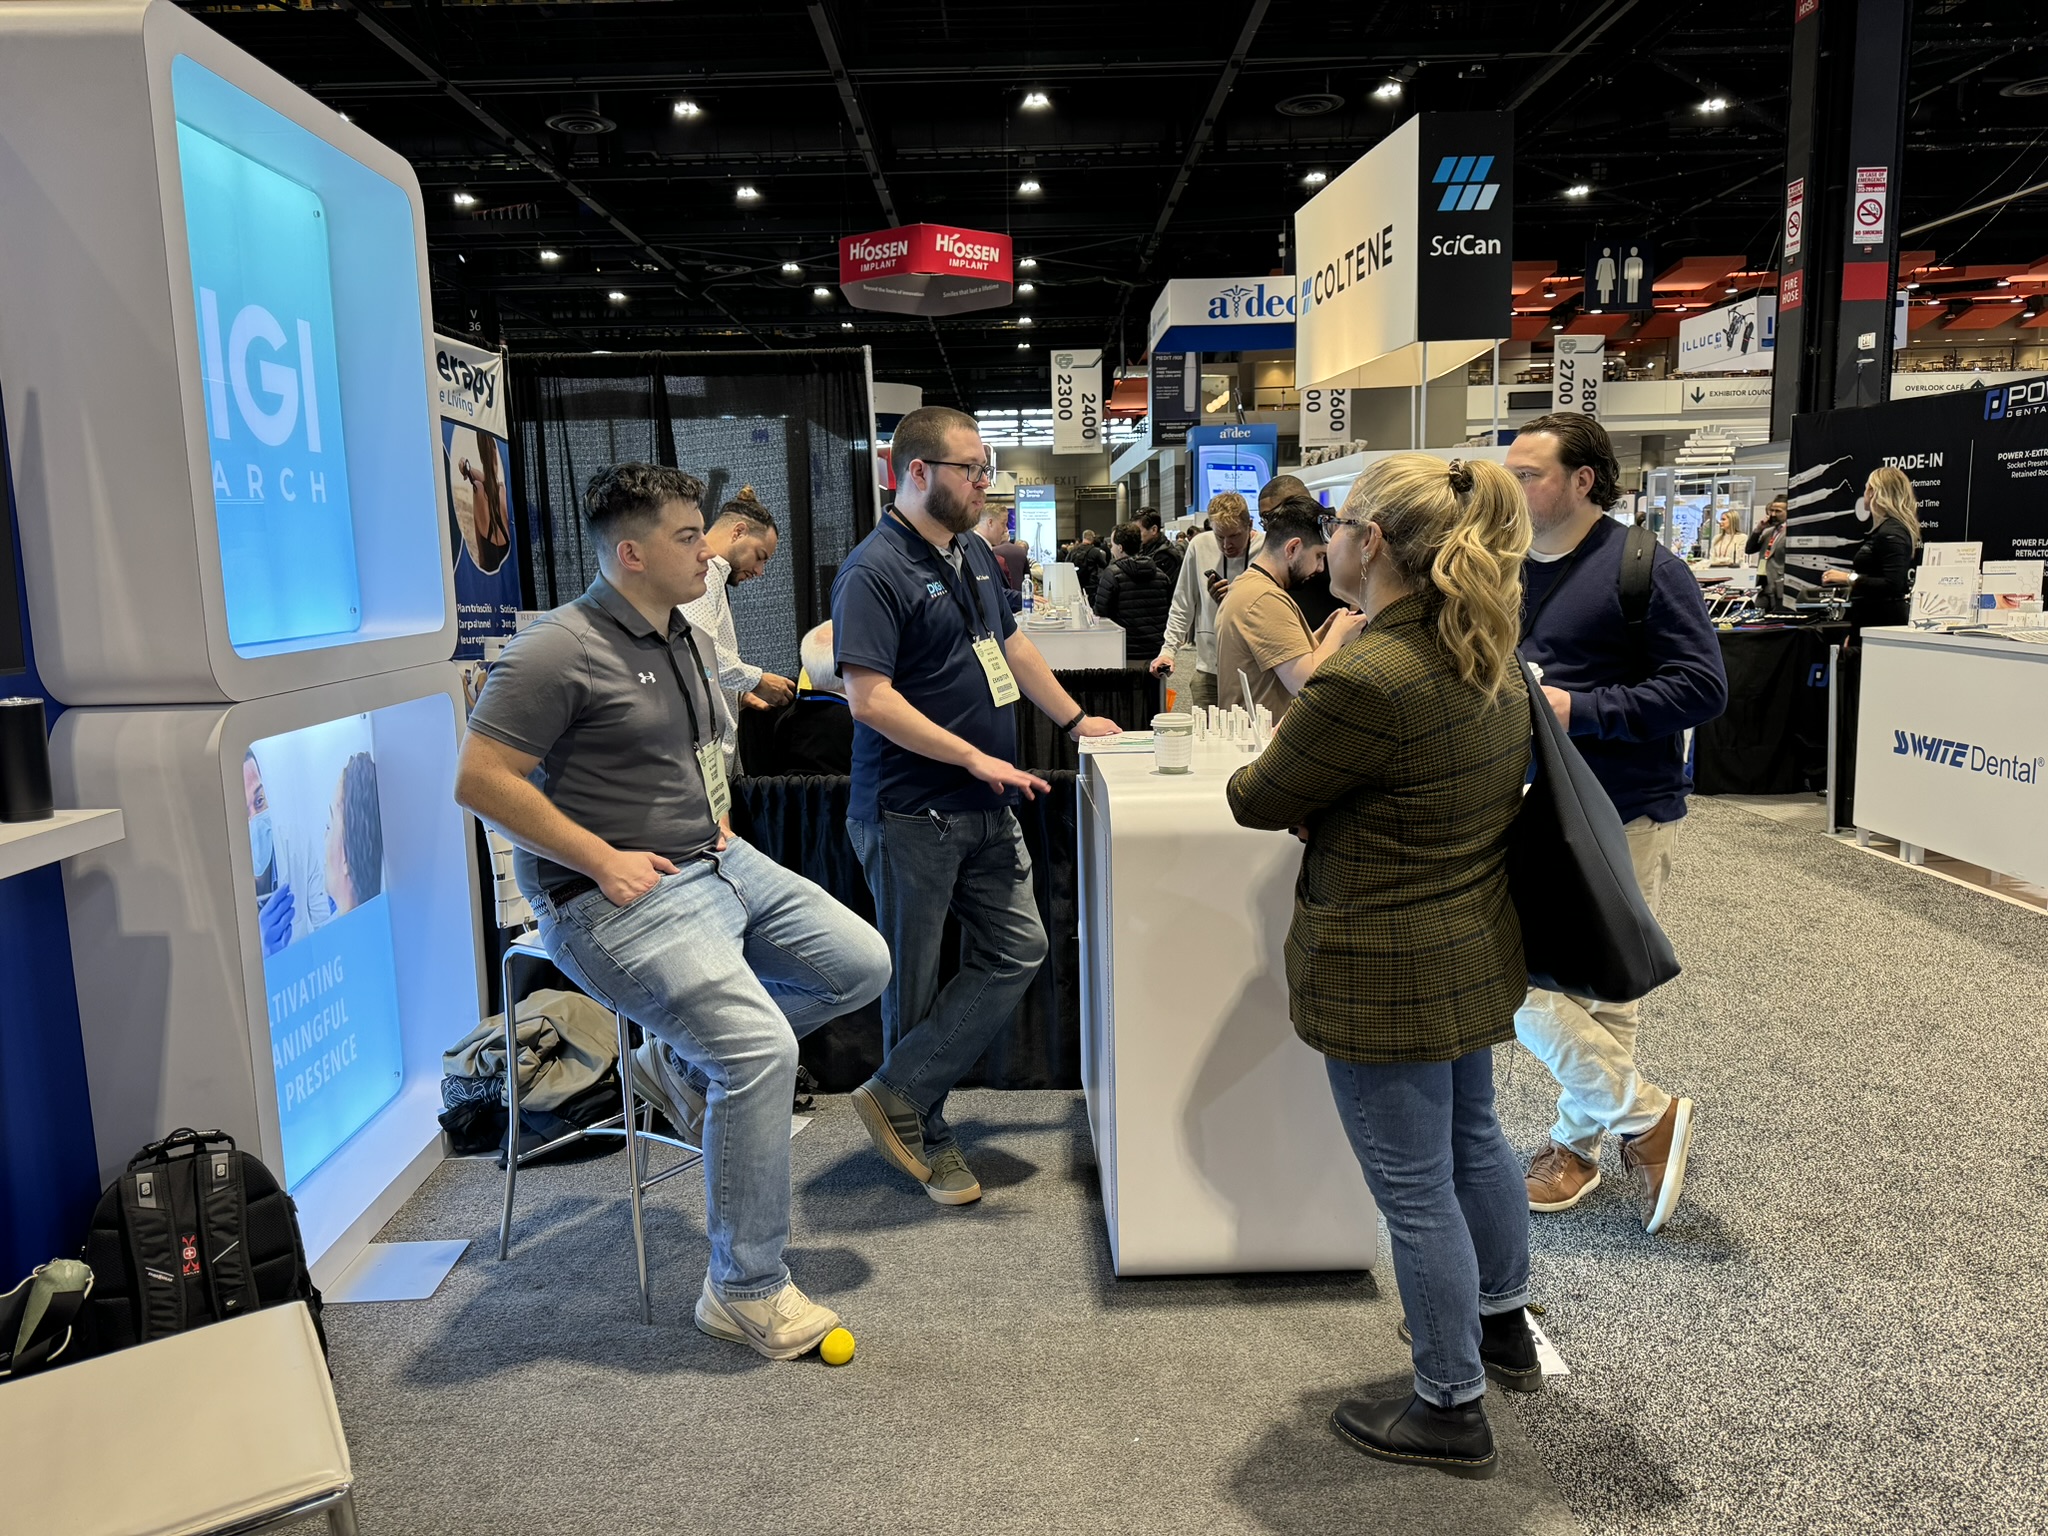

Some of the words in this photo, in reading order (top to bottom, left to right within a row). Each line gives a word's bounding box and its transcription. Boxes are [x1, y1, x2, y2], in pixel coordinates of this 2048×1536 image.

[1429, 234, 1502, 256] SciCan
[860, 258, 897, 272] IMPLANT
[949, 258, 989, 271] IMPLANT
[1314, 223, 1393, 306] COLTENE
[1784, 276, 1798, 292] FIRE
[943, 289, 959, 298] Smiles
[959, 287, 969, 296] that
[1782, 289, 1799, 305] HOSE
[470, 309, 478, 319] V
[468, 321, 481, 332] 36
[1682, 332, 1722, 353] ILLUCO
[437, 350, 496, 409] erapy
[1558, 359, 1575, 405] 2700
[1904, 384, 1945, 392] OVERLOOK
[1946, 383, 1965, 391] CAFÉ
[1057, 373, 1073, 421] 2300
[1709, 389, 1747, 397] EXHIBITOR
[447, 389, 474, 417] Living
[1330, 388, 1346, 432] 2600
[1081, 393, 1097, 440] 2400
[2006, 405, 2047, 418] DENTA
[1882, 452, 1943, 470] TRADE-IN
[1997, 451, 2024, 461] POWER
[2007, 462, 2027, 470] Socket
[2011, 469, 2037, 479] Retained
[1054, 476, 1078, 486] EXIT
[1925, 499, 1940, 508] Time
[2012, 538, 2037, 547] POWER
[1909, 732, 1970, 768] WHITE
[271, 955, 344, 1027] TIVATING
[284, 1033, 358, 1112] PRESENCE
